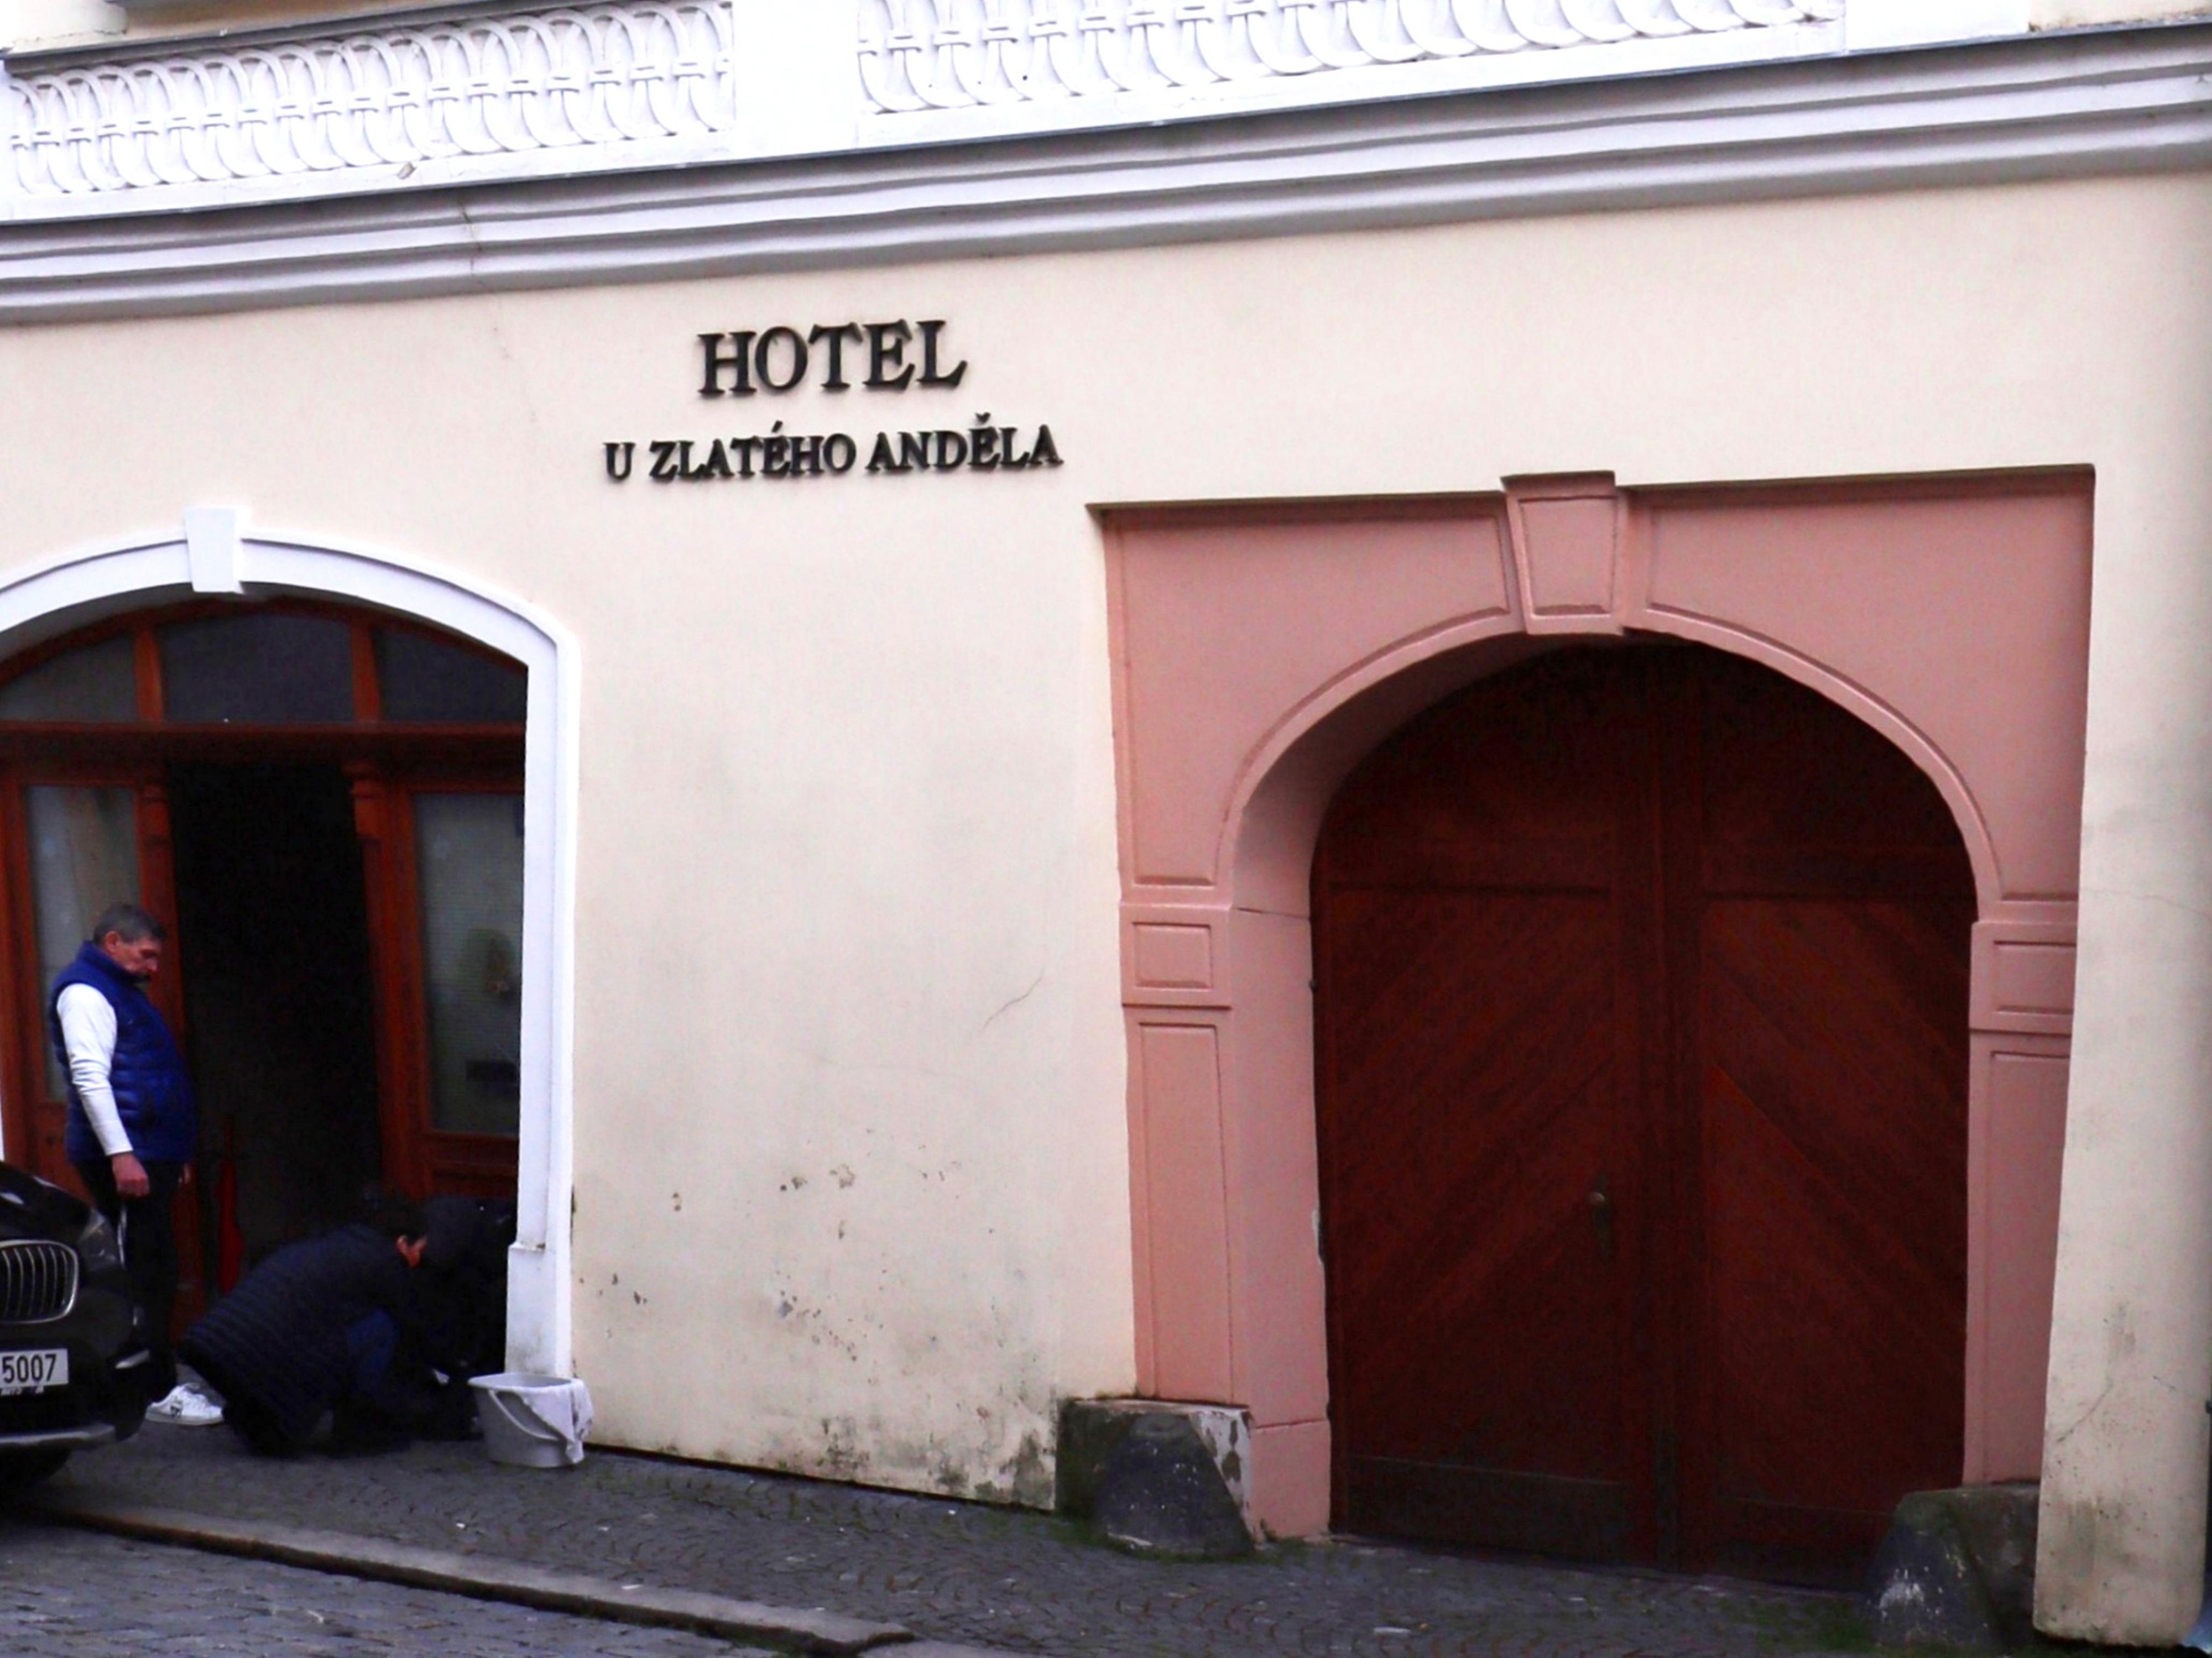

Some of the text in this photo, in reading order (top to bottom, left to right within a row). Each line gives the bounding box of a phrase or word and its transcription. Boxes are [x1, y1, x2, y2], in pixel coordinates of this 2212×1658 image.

[696, 318, 968, 400] HOTEL
[604, 412, 1064, 484] U ZLATÉHO ANDĚLA
[2, 1353, 56, 1383] 5007
